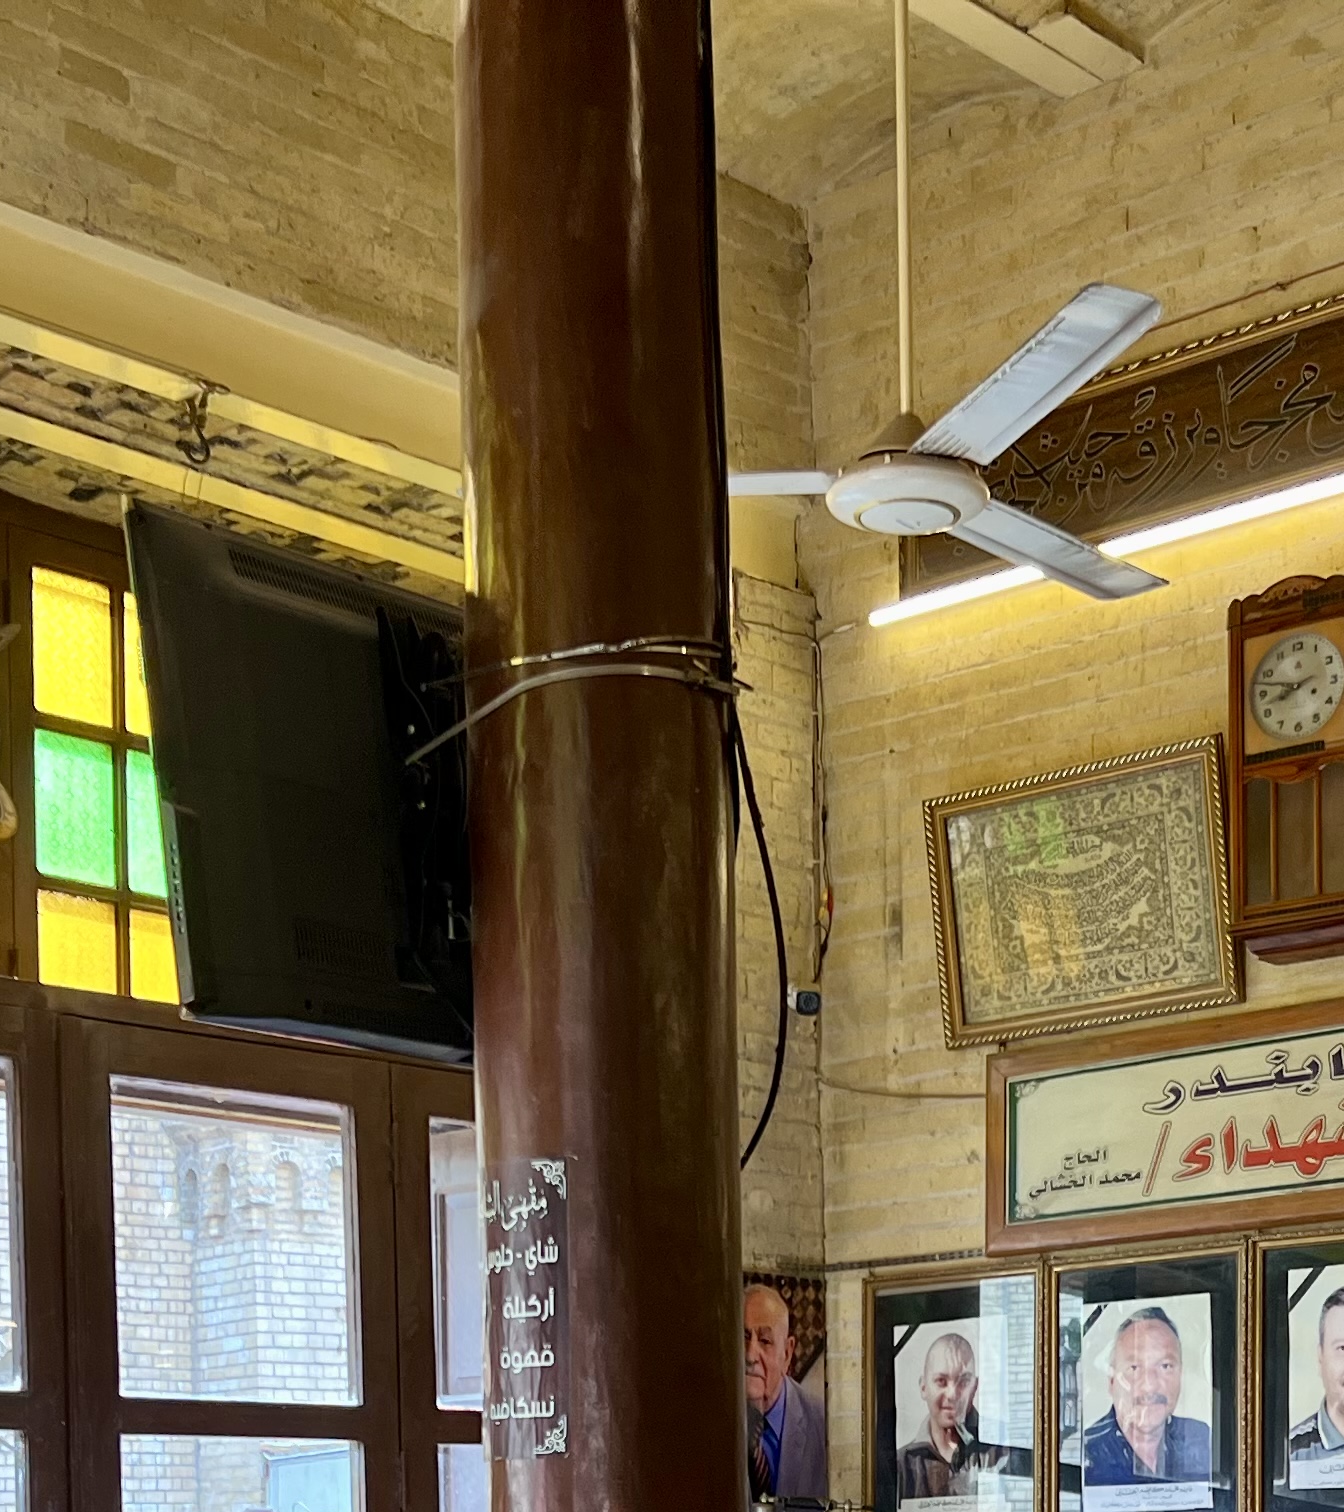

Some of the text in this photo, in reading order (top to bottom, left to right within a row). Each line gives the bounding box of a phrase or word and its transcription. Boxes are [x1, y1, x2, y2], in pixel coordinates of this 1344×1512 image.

[1063, 1148, 1108, 1171] الحاج
[1028, 1169, 1142, 1201] محمد الخشالي
[524, 1236, 559, 1277] شاي
[502, 1286, 555, 1323] أركيلة
[500, 1343, 555, 1374] قهوة
